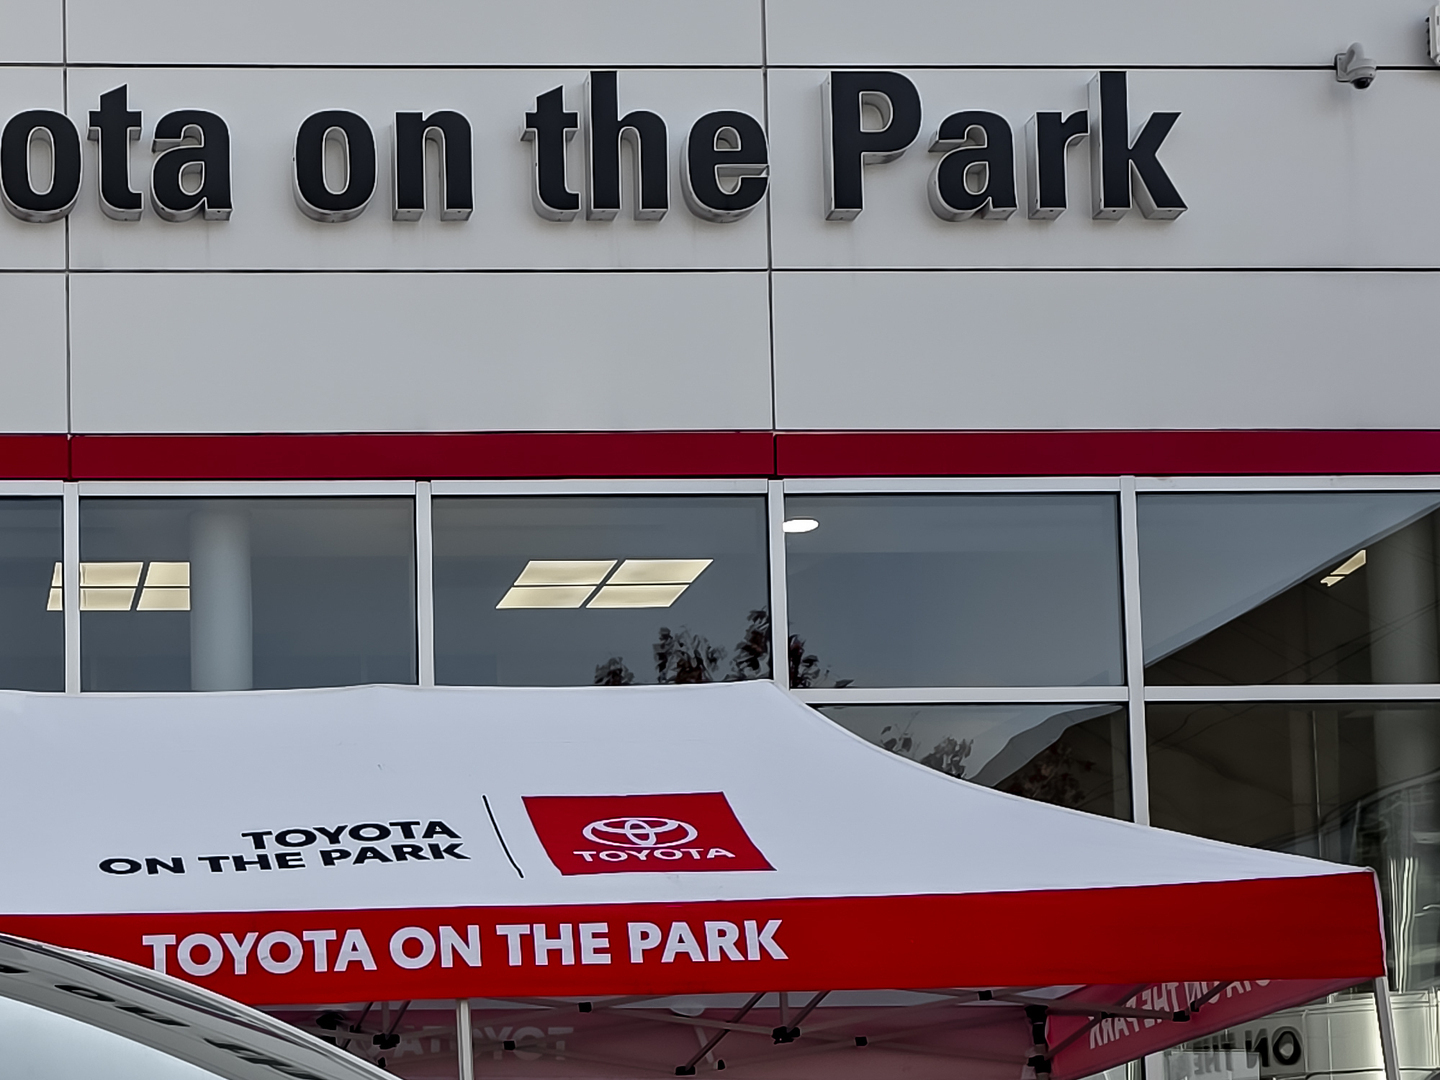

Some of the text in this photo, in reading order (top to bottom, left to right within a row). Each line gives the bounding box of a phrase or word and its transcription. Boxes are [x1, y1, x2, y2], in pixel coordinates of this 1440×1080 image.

[292, 108, 474, 223] on
[522, 70, 770, 223] the
[822, 70, 1189, 223] Park
[241, 820, 463, 850] TOYOTA
[98, 842, 472, 876] ON THE PARK
[572, 847, 737, 863] TOYOTA
[141, 919, 789, 977] TOYOTA ON THE PARK
